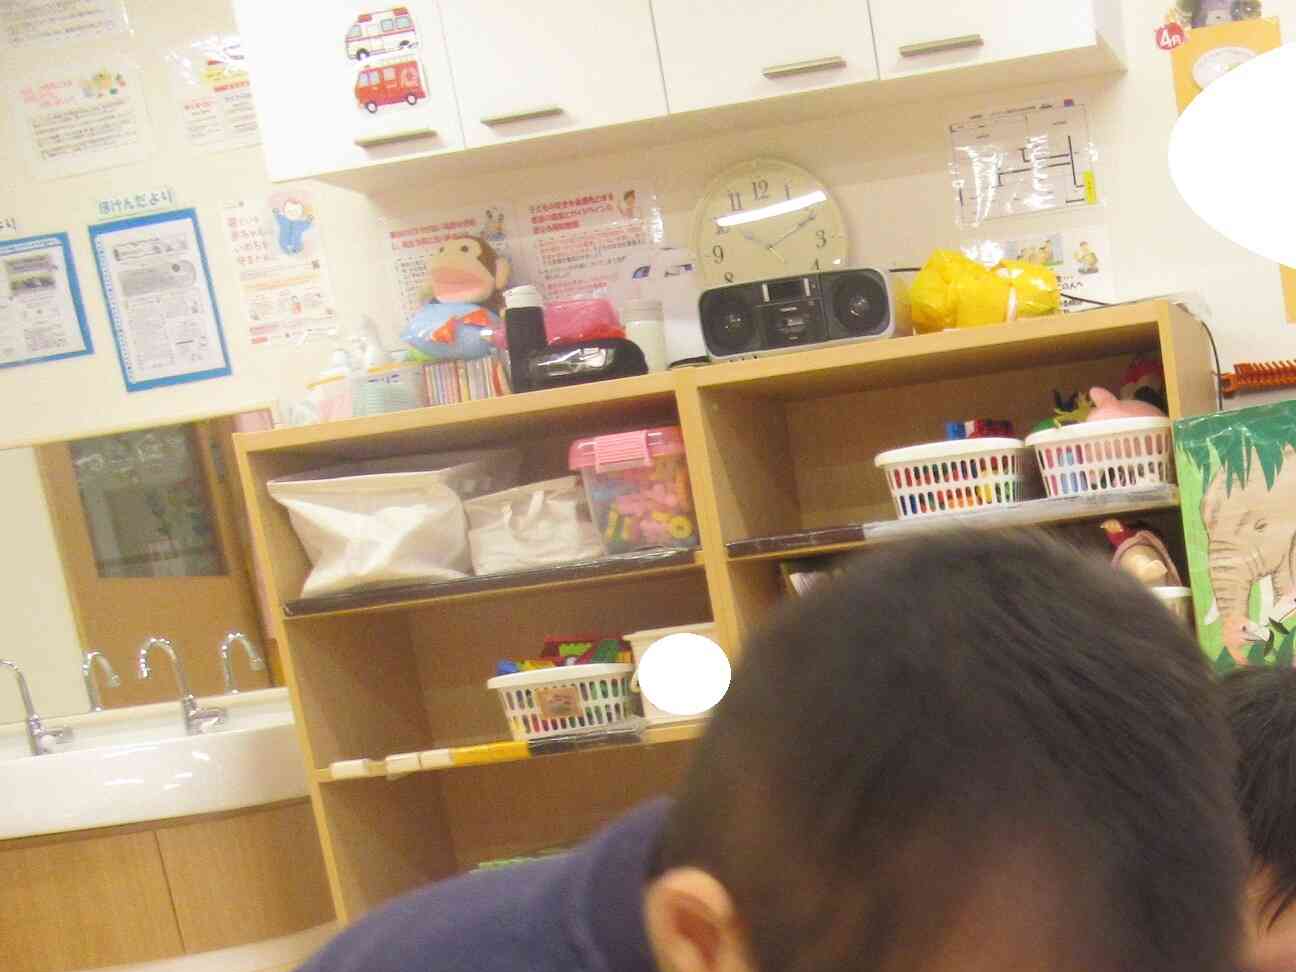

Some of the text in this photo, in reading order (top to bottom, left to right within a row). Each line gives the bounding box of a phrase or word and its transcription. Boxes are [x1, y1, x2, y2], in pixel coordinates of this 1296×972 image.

[752, 180, 769, 200] 12
[729, 192, 742, 212] 11
[815, 229, 827, 249] 3
[712, 244, 725, 265] 9
